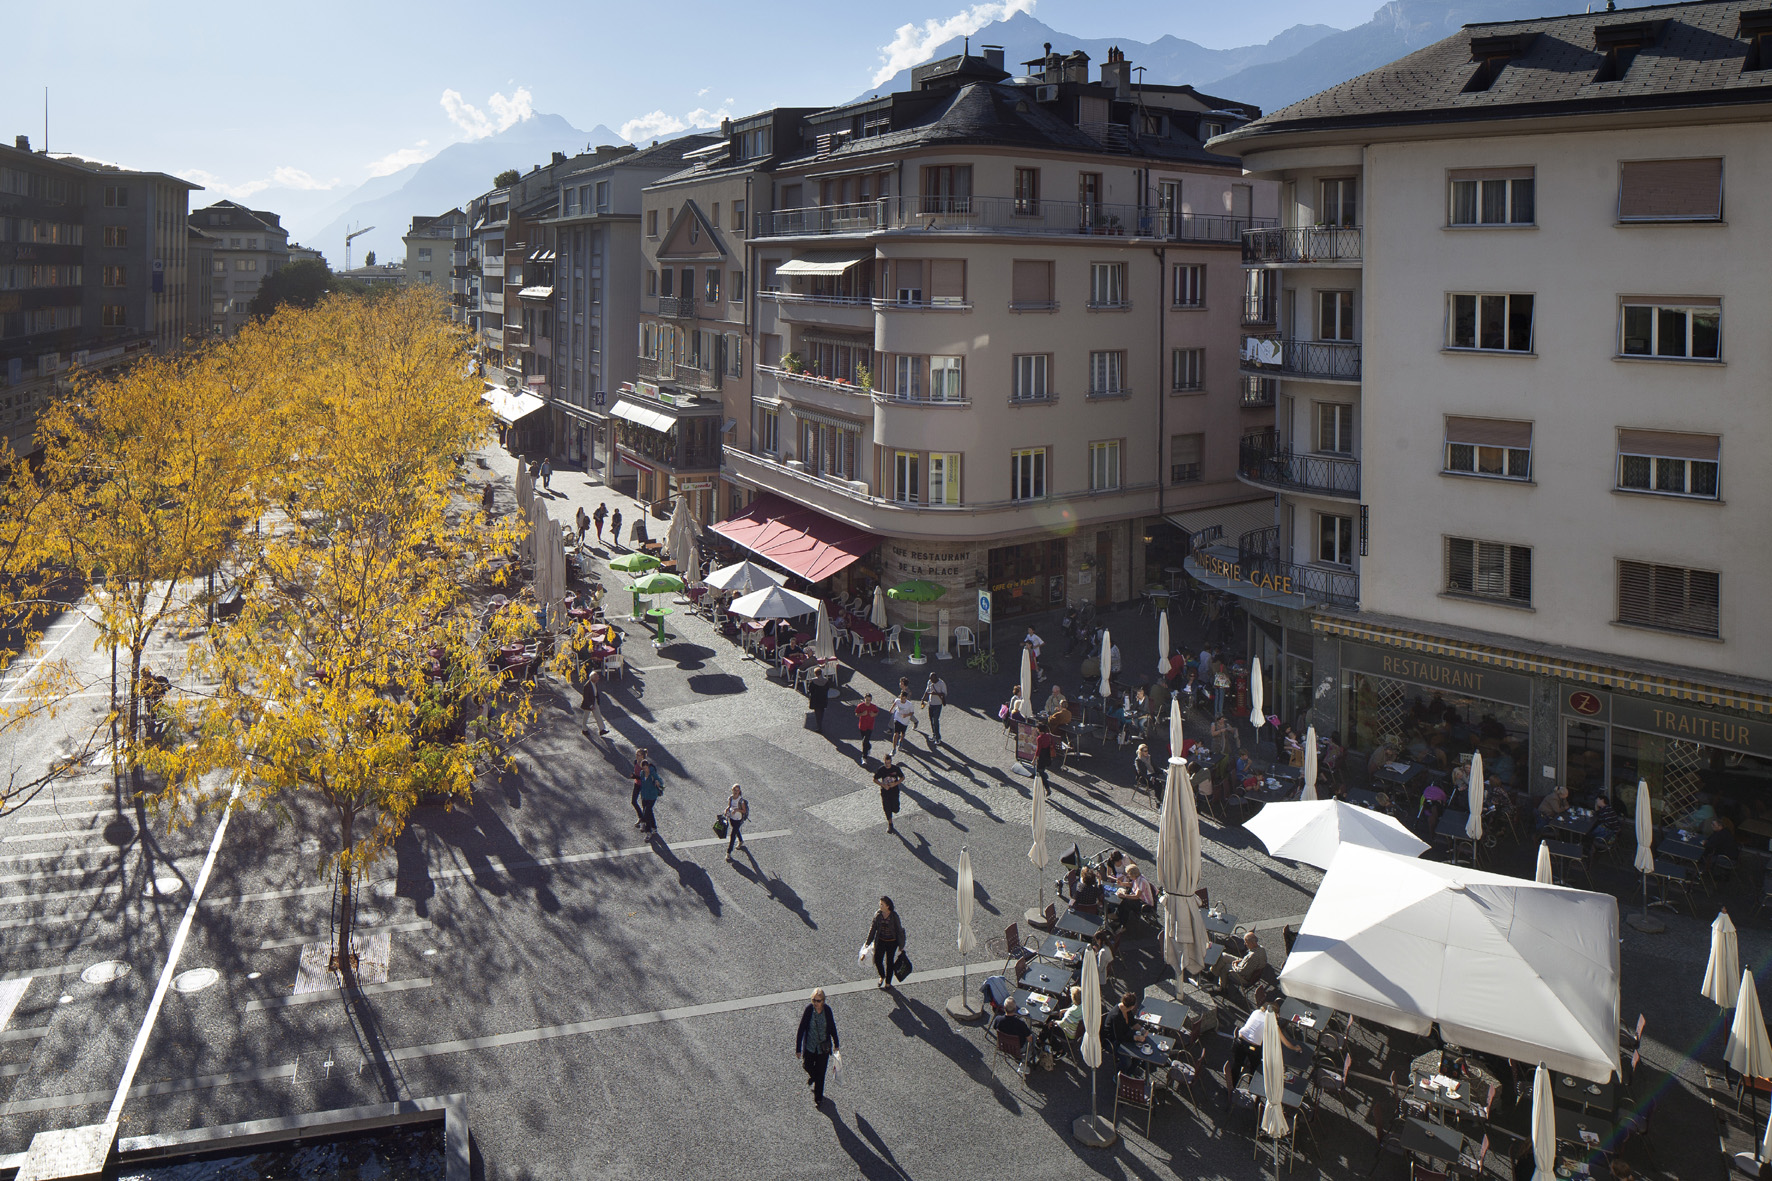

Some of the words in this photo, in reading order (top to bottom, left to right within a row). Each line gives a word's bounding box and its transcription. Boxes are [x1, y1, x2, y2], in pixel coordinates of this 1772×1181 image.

[911, 551, 970, 561] RESTAURANT
[899, 562, 908, 571] DE
[911, 565, 922, 574] LA
[928, 567, 959, 575] PLACE
[1250, 570, 1293, 594] CAFE
[1383, 655, 1484, 691] RESTAURANT
[1653, 709, 1750, 745] TRAITEUR
